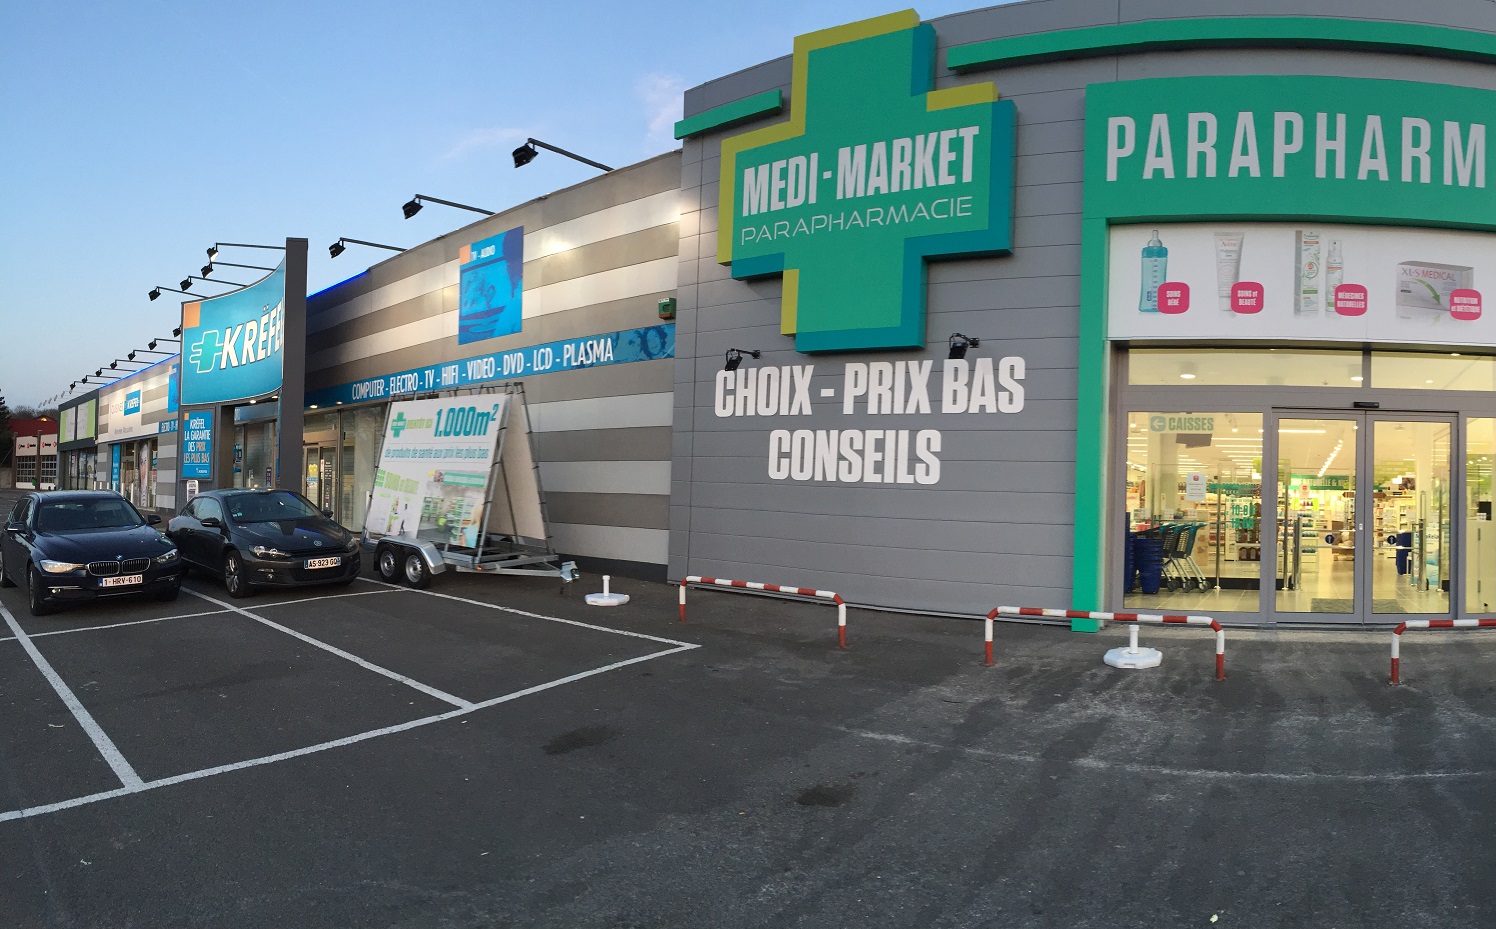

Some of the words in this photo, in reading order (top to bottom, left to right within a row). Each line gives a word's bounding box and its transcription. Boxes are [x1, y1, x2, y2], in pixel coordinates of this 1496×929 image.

[741, 196, 974, 246] PARAPHARMACIE
[1421, 269, 1457, 282] MEDICAL
[352, 379, 385, 400] COMPUTER
[389, 375, 419, 395] ELECTRO
[424, 373, 435, 389] TV
[441, 364, 459, 386] HIFI
[467, 356, 496, 381] VIDEO
[502, 352, 524, 376] DVD
[532, 347, 553, 371] LCD
[563, 337, 614, 367] PLASMA
[714, 364, 815, 418] CHOIX
[842, 360, 933, 415] PRIX
[941, 356, 1026, 415] BAS
[184, 430, 190, 440] LA
[1168, 417, 1215, 431] CAISSES
[187, 442, 196, 452] DES
[768, 429, 942, 485] CONSEILS
